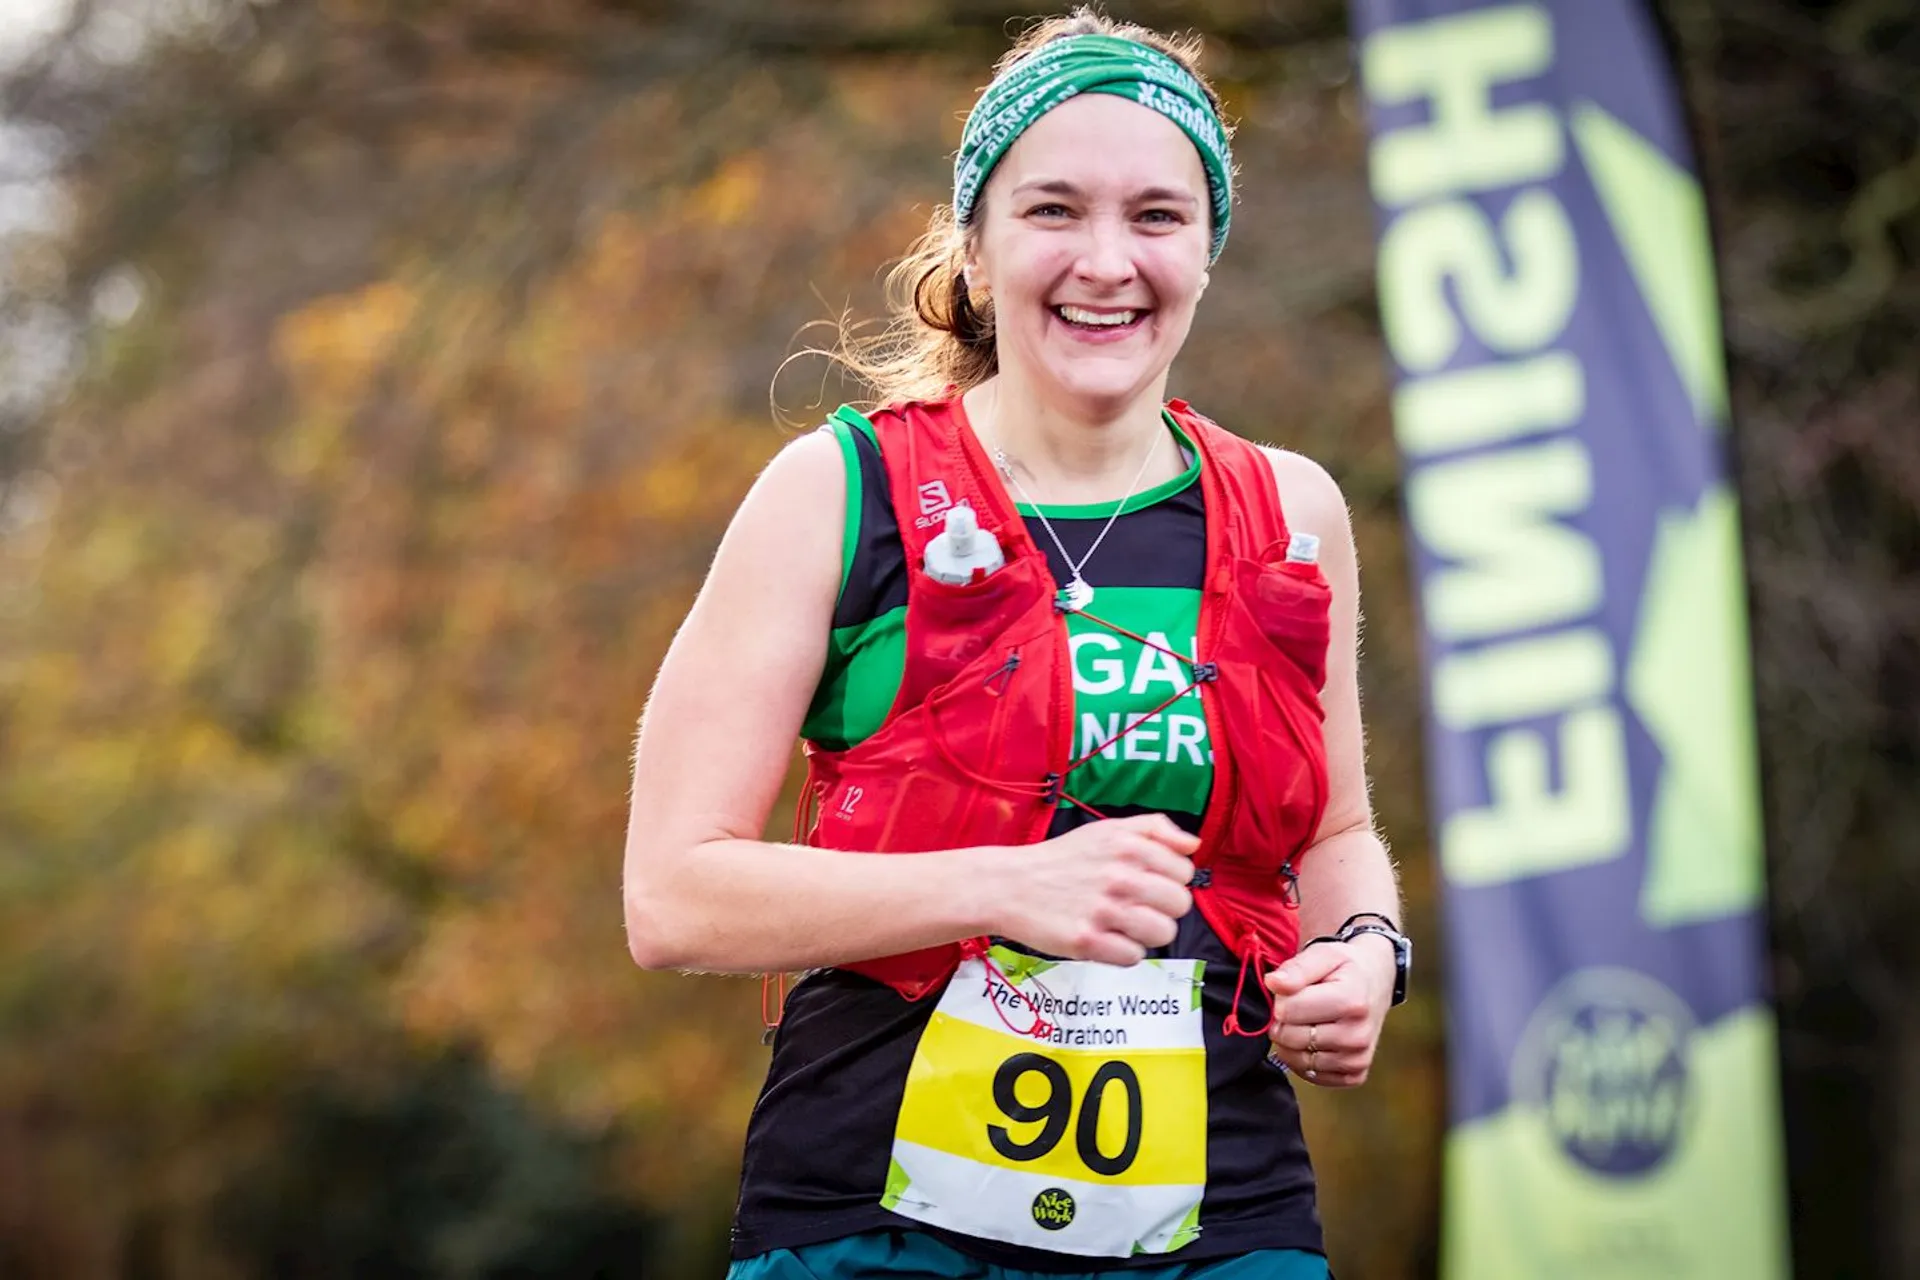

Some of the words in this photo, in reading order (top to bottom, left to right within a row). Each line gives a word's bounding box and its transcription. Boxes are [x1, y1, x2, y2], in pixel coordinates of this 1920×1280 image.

[1068, 712, 1214, 766] NER
[841, 785, 863, 814] 12
[982, 978, 1021, 1009] The
[1026, 991, 1112, 1017] Wendover
[1118, 995, 1180, 1015] Woods
[987, 1052, 1143, 1177] 90
[1034, 1206, 1072, 1223] Work
[1039, 1192, 1072, 1210] Nice
